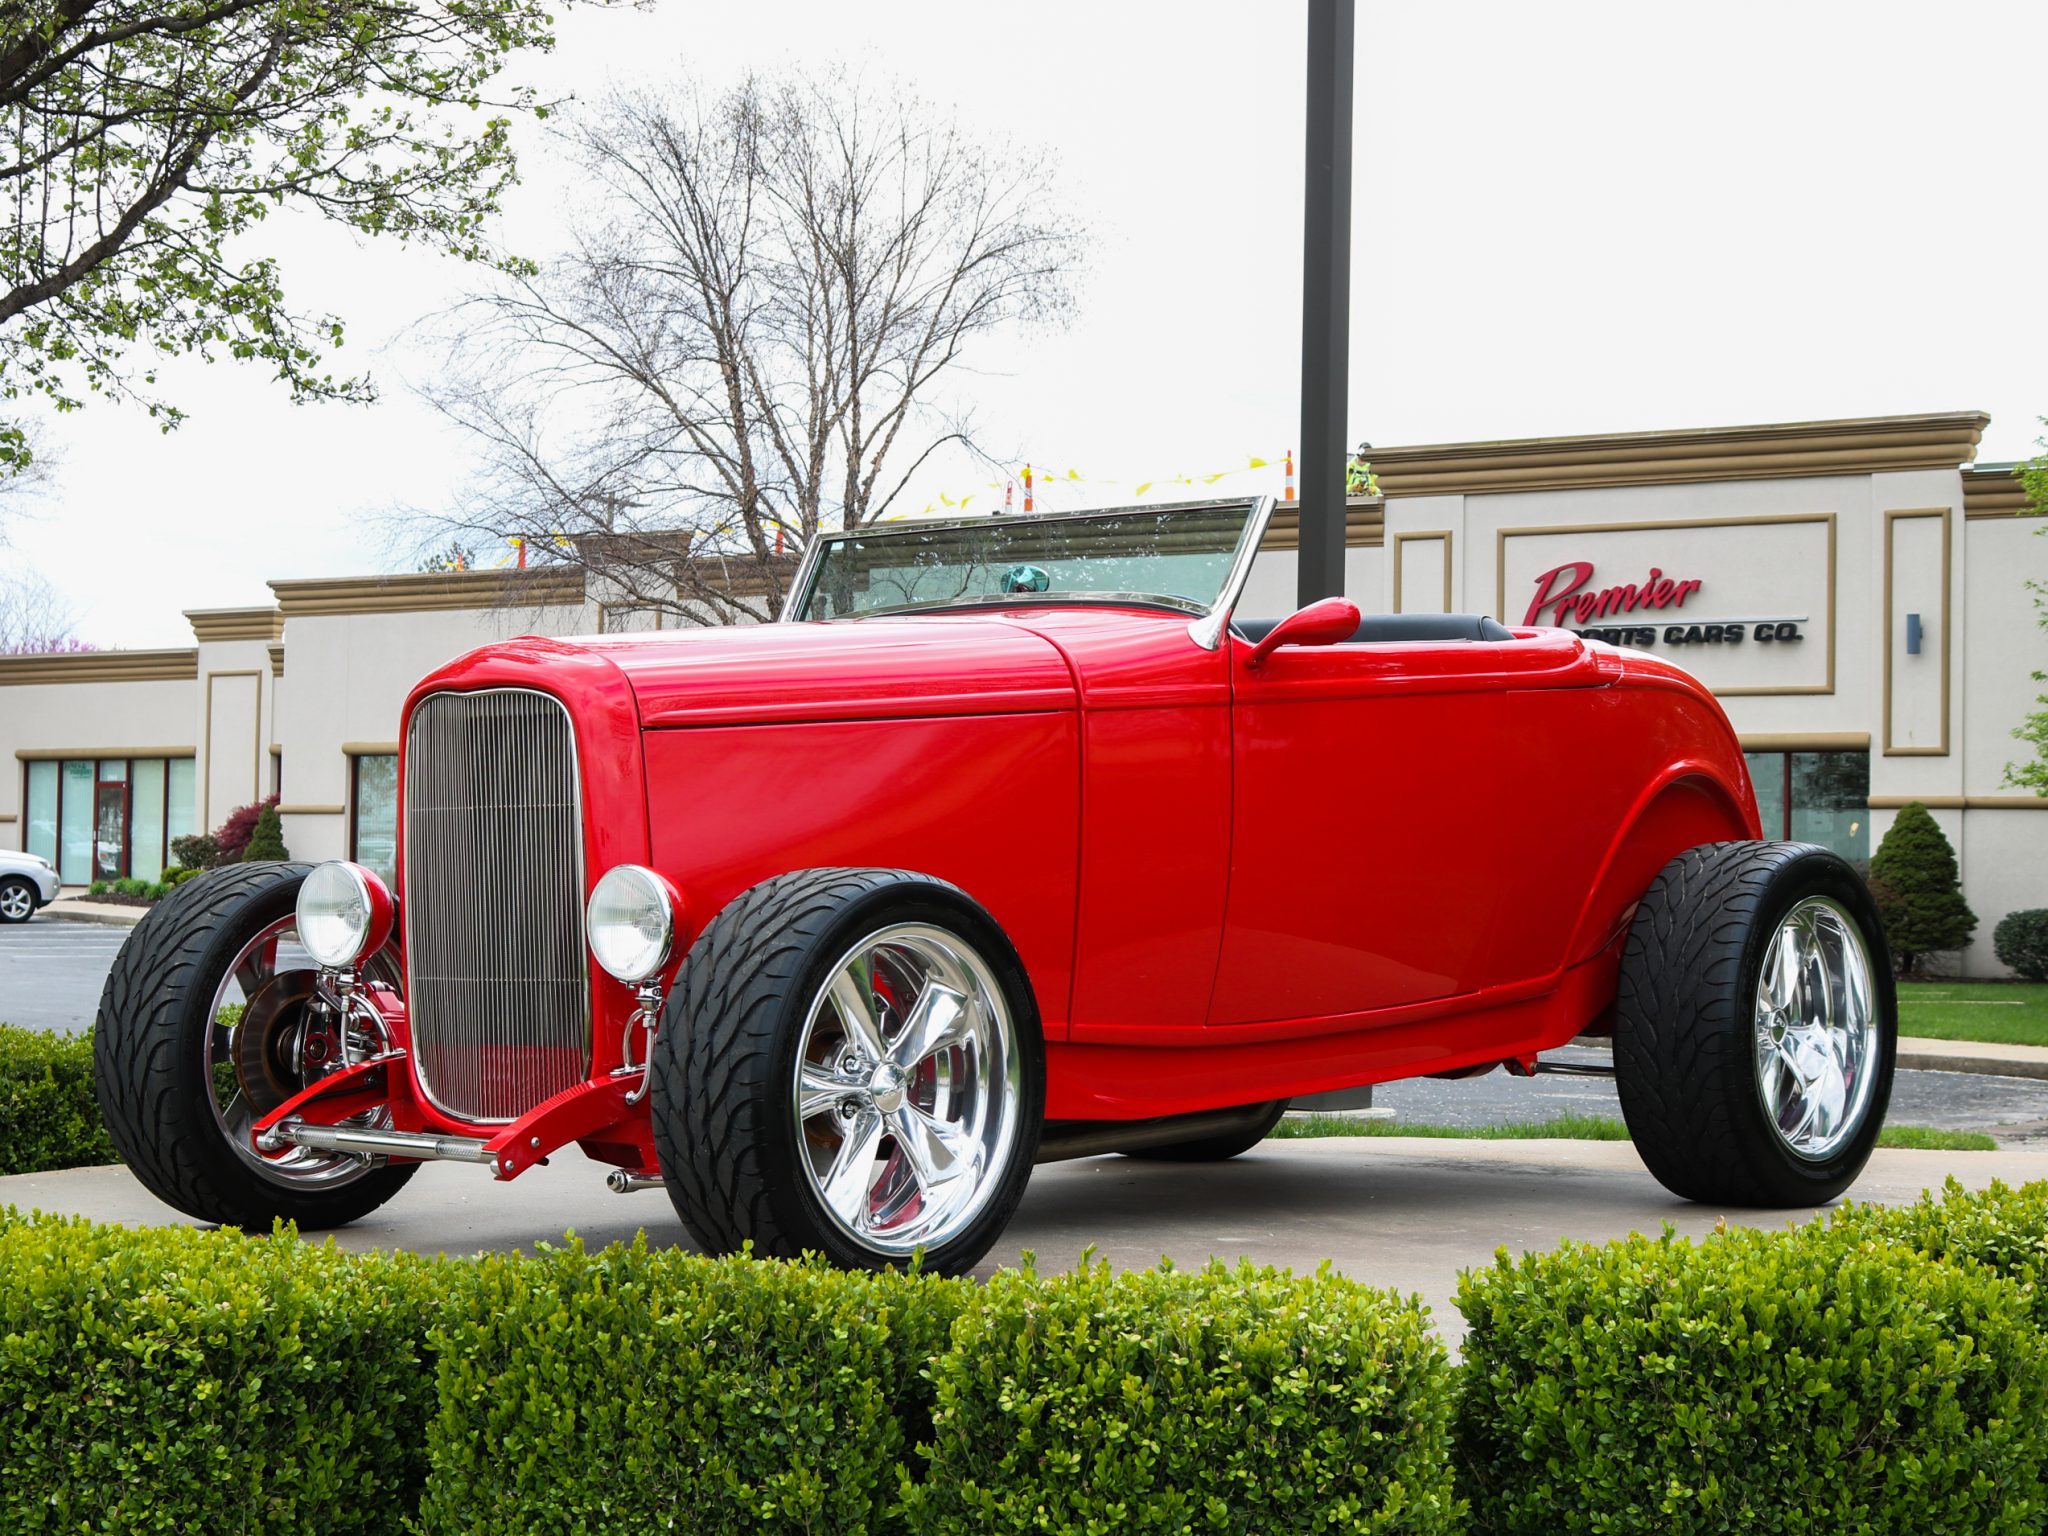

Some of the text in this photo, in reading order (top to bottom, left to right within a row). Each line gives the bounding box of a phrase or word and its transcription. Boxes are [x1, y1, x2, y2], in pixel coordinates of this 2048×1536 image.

[1523, 561, 1702, 627] Premier
[1571, 622, 1804, 647] ORTS CARS CO.
